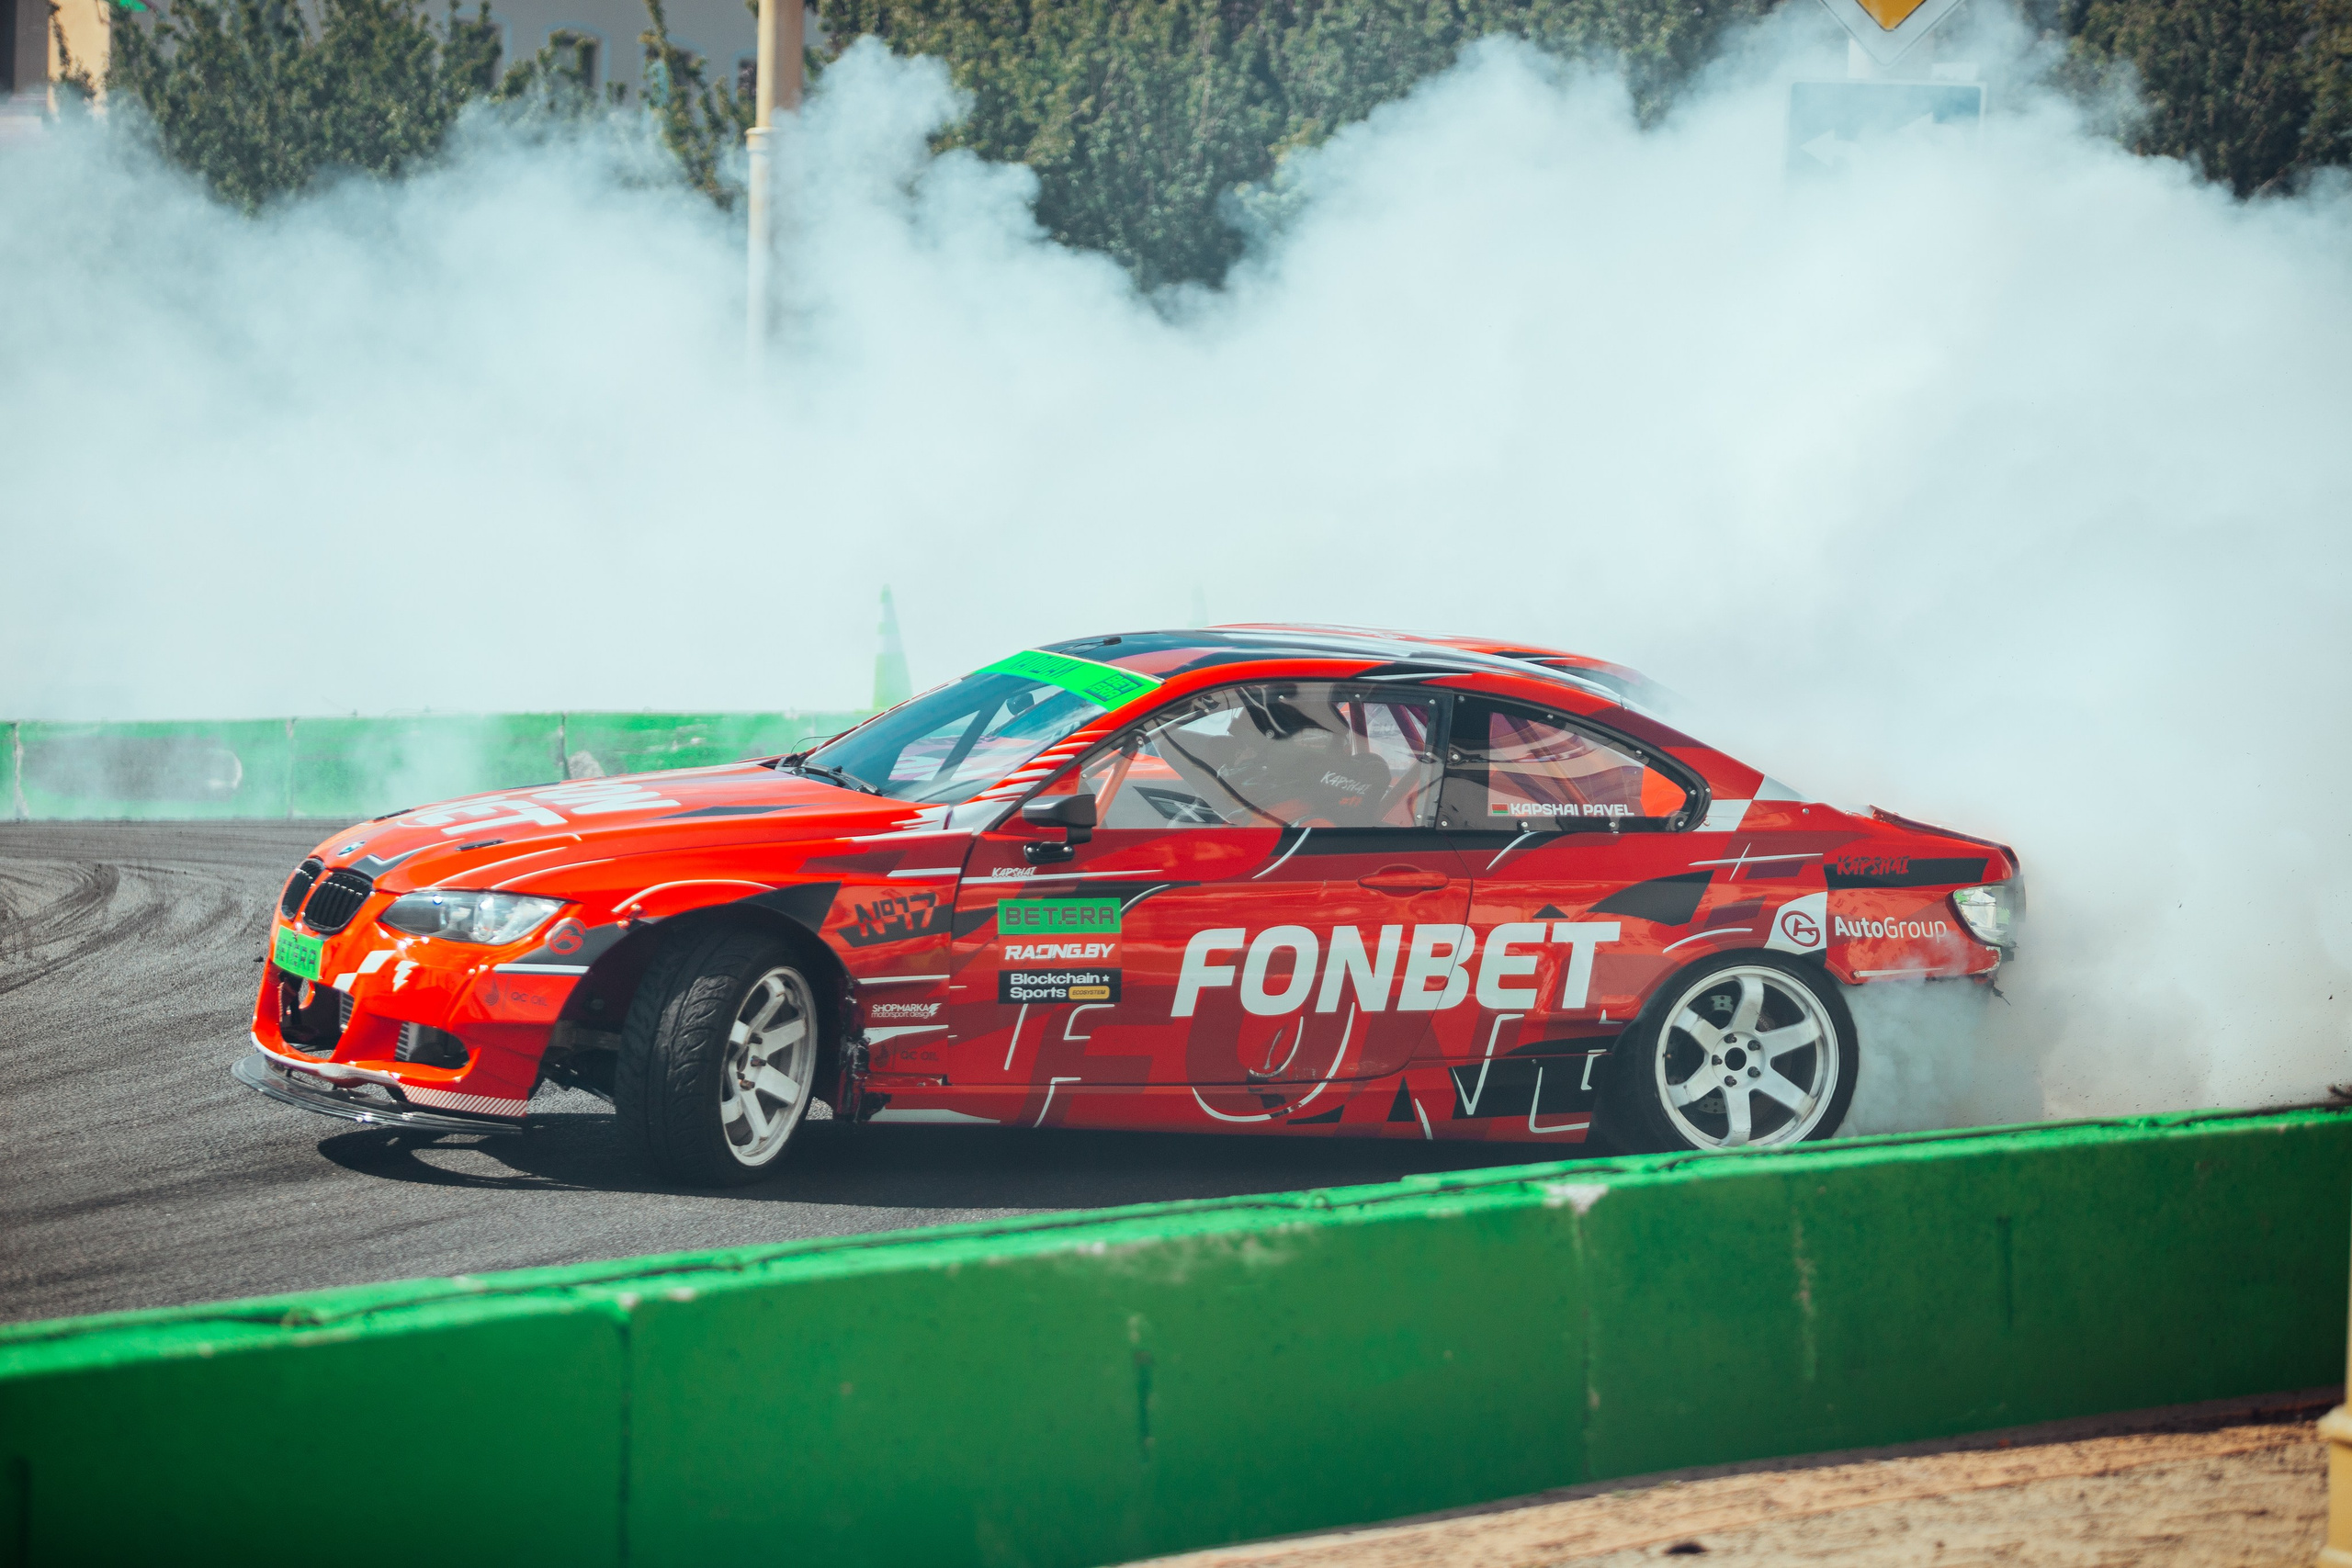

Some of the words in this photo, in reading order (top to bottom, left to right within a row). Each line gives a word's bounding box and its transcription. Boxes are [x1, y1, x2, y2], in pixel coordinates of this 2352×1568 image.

[1320, 771, 1372, 795] KAPSHAI
[1510, 803, 1578, 816] KAPSHAI
[1584, 804, 1634, 816] PAVEL
[991, 866, 1037, 878] KAPSHAI
[1837, 855, 1910, 875] KAPSHAI
[1835, 916, 1947, 943] AutoGroup
[1004, 943, 1115, 960] RACING.BY
[1170, 921, 1622, 1018] FONBET
[1011, 972, 1100, 985] Blockchain
[1010, 987, 1067, 1000] Sports
[872, 1003, 929, 1011] SHOPMARKA
